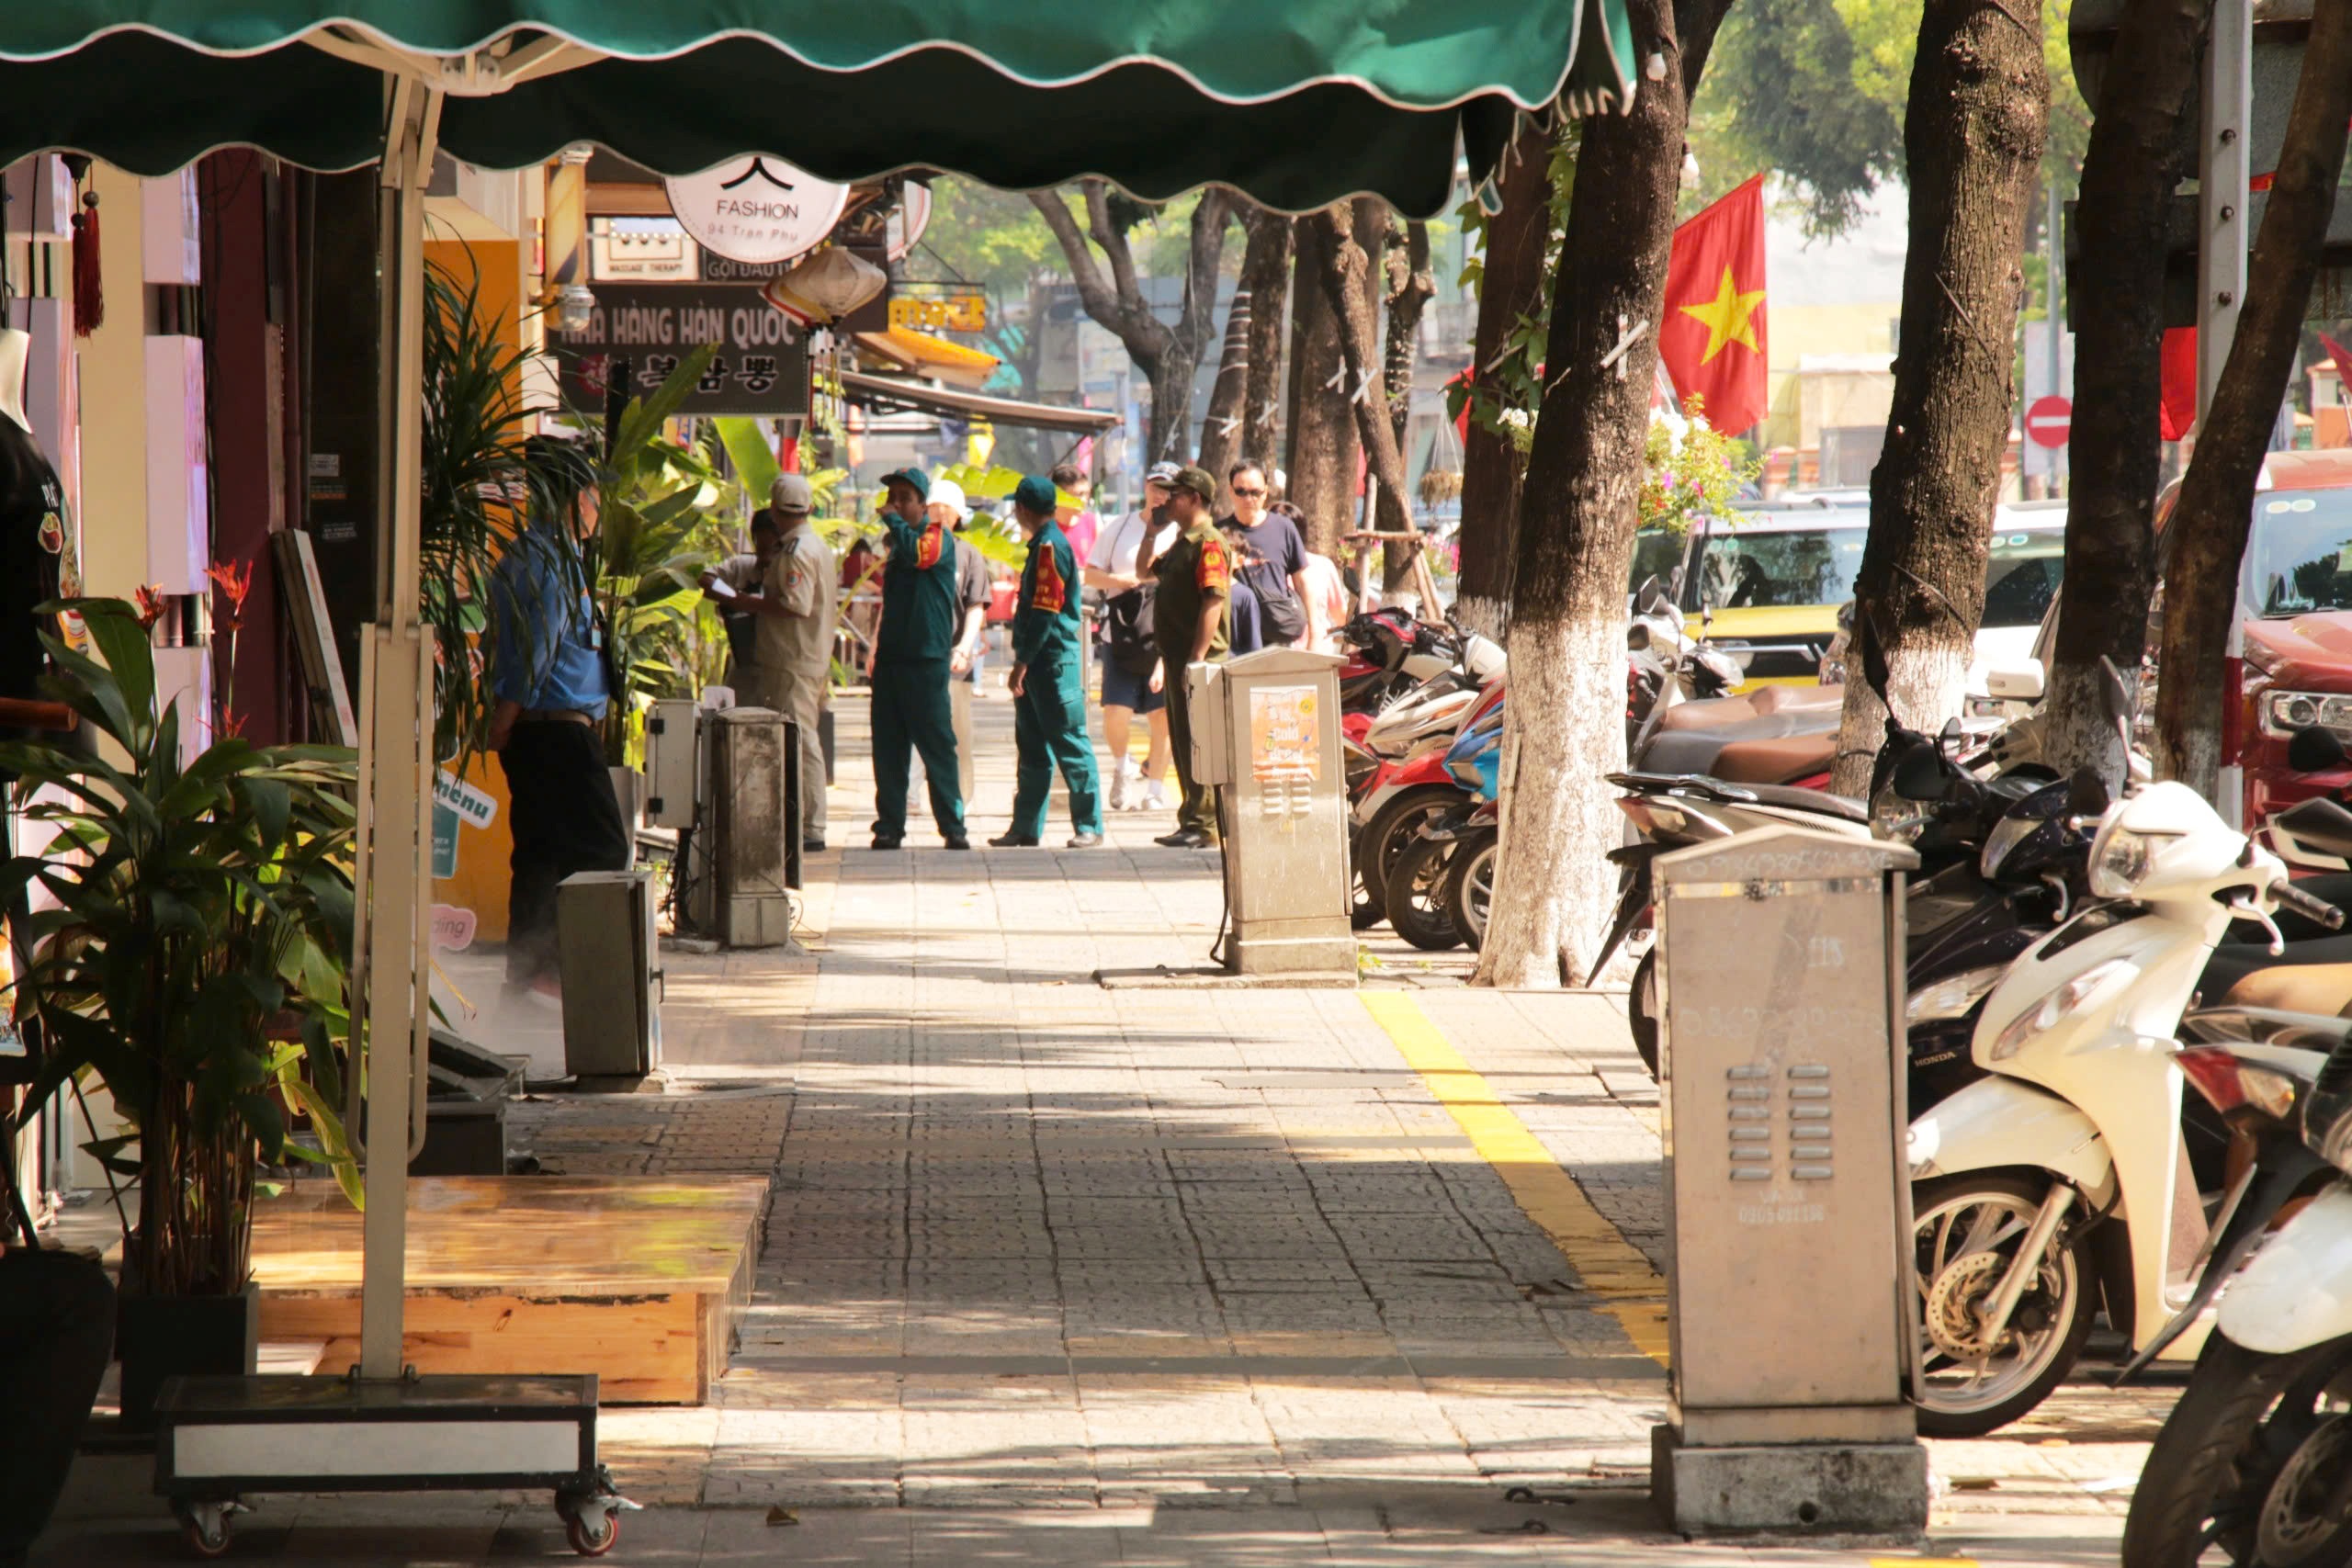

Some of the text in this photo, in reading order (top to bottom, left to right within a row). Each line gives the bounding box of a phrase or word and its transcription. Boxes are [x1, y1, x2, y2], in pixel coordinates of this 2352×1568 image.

[717, 199, 798, 220] FASHION
[613, 299, 673, 345] HÀNG
[680, 299, 725, 344] HÀN
[1914, 1051, 1956, 1066] HONDA
